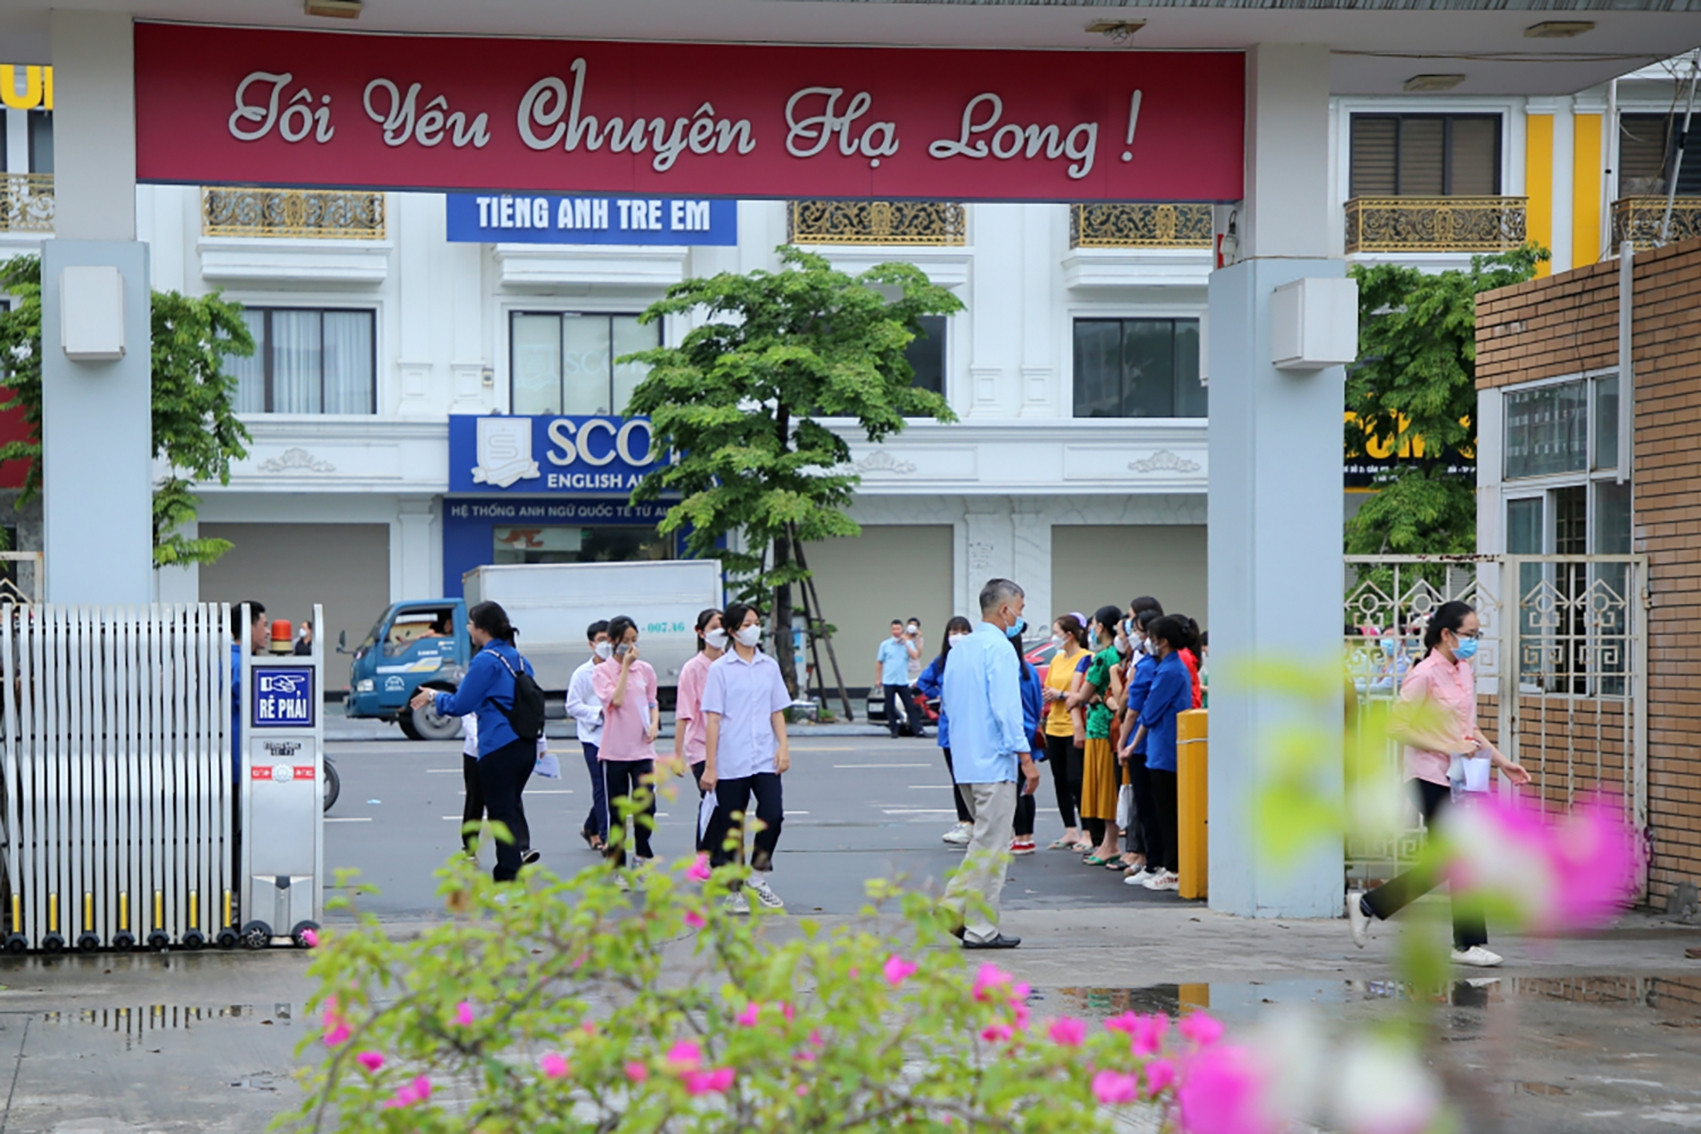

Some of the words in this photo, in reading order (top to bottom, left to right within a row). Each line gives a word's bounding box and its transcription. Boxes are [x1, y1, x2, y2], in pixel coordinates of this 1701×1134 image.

[229, 70, 335, 145] Tôi
[363, 77, 491, 148] Yêu
[516, 56, 757, 173] Chuyên
[784, 86, 900, 169] Hạ
[927, 91, 1099, 180] Long
[557, 197, 609, 230] ANH
[670, 200, 711, 231] EM
[547, 473, 623, 489] ENGLISH
[471, 502, 516, 518] THỐNG
[518, 505, 546, 518] ANH
[577, 502, 614, 518] QUỐC
